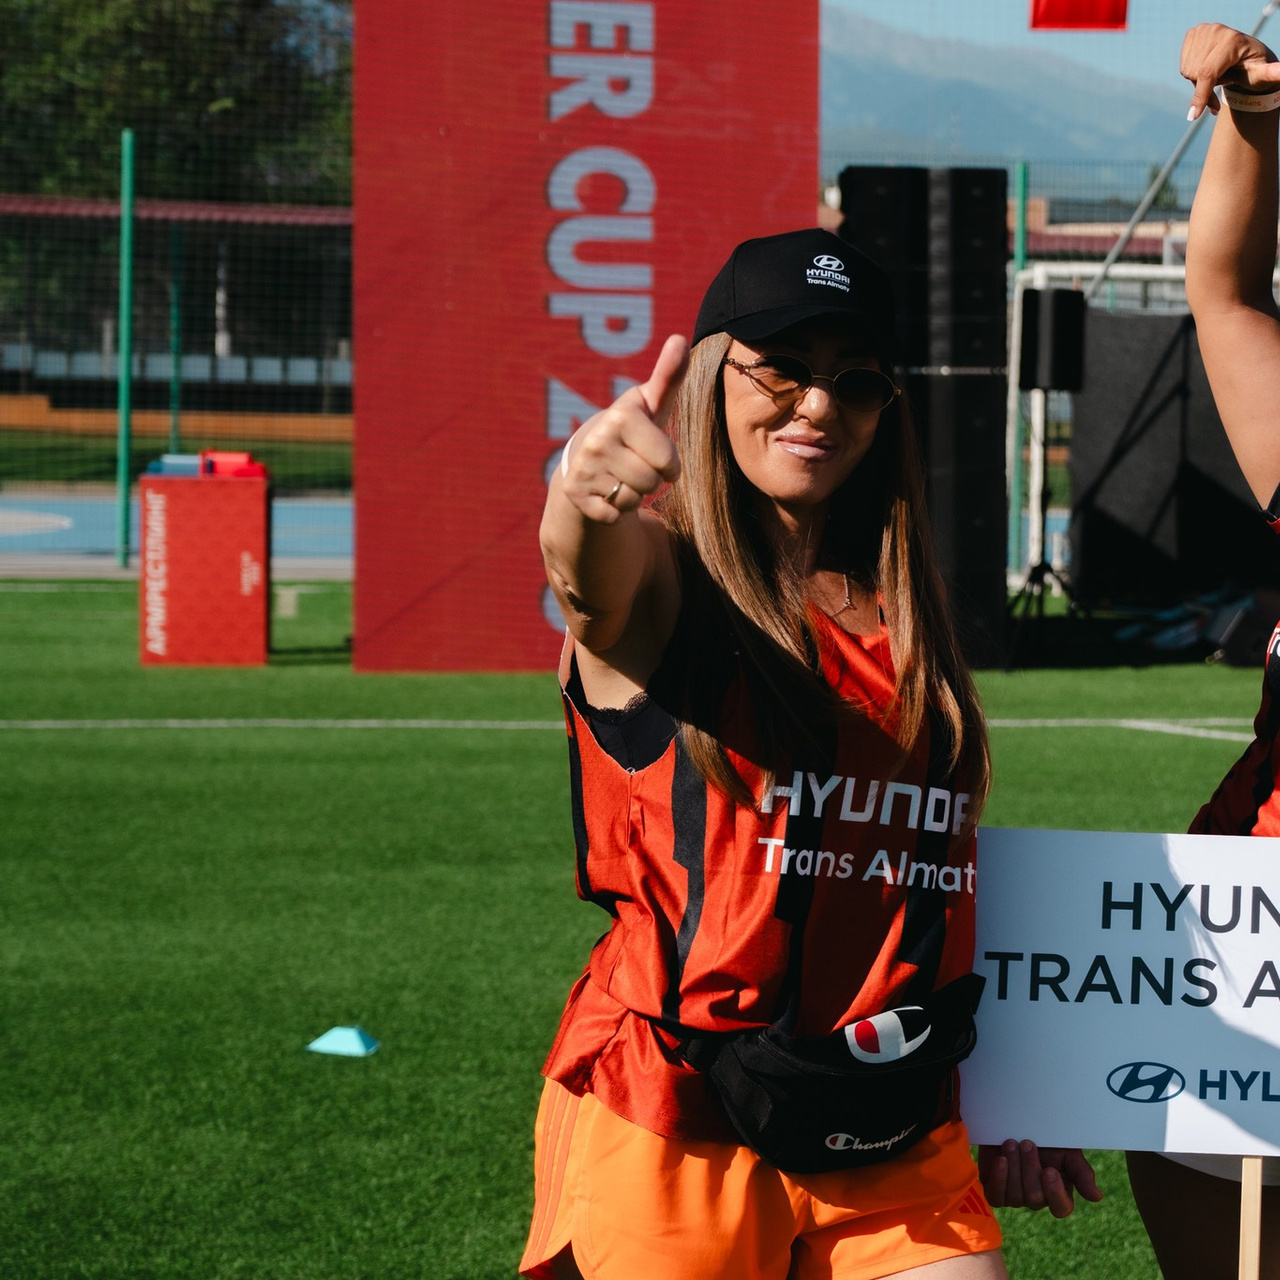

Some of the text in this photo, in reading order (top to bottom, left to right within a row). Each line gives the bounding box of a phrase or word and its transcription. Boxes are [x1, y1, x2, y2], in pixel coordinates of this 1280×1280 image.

[546, 145, 659, 358] CUP
[806, 268, 851, 285] HYUNDAI
[807, 277, 851, 293] Trans Almaty
[759, 769, 978, 837] HYUNDA
[757, 836, 977, 898] Trans Almat
[984, 949, 1220, 1009] TRANS
